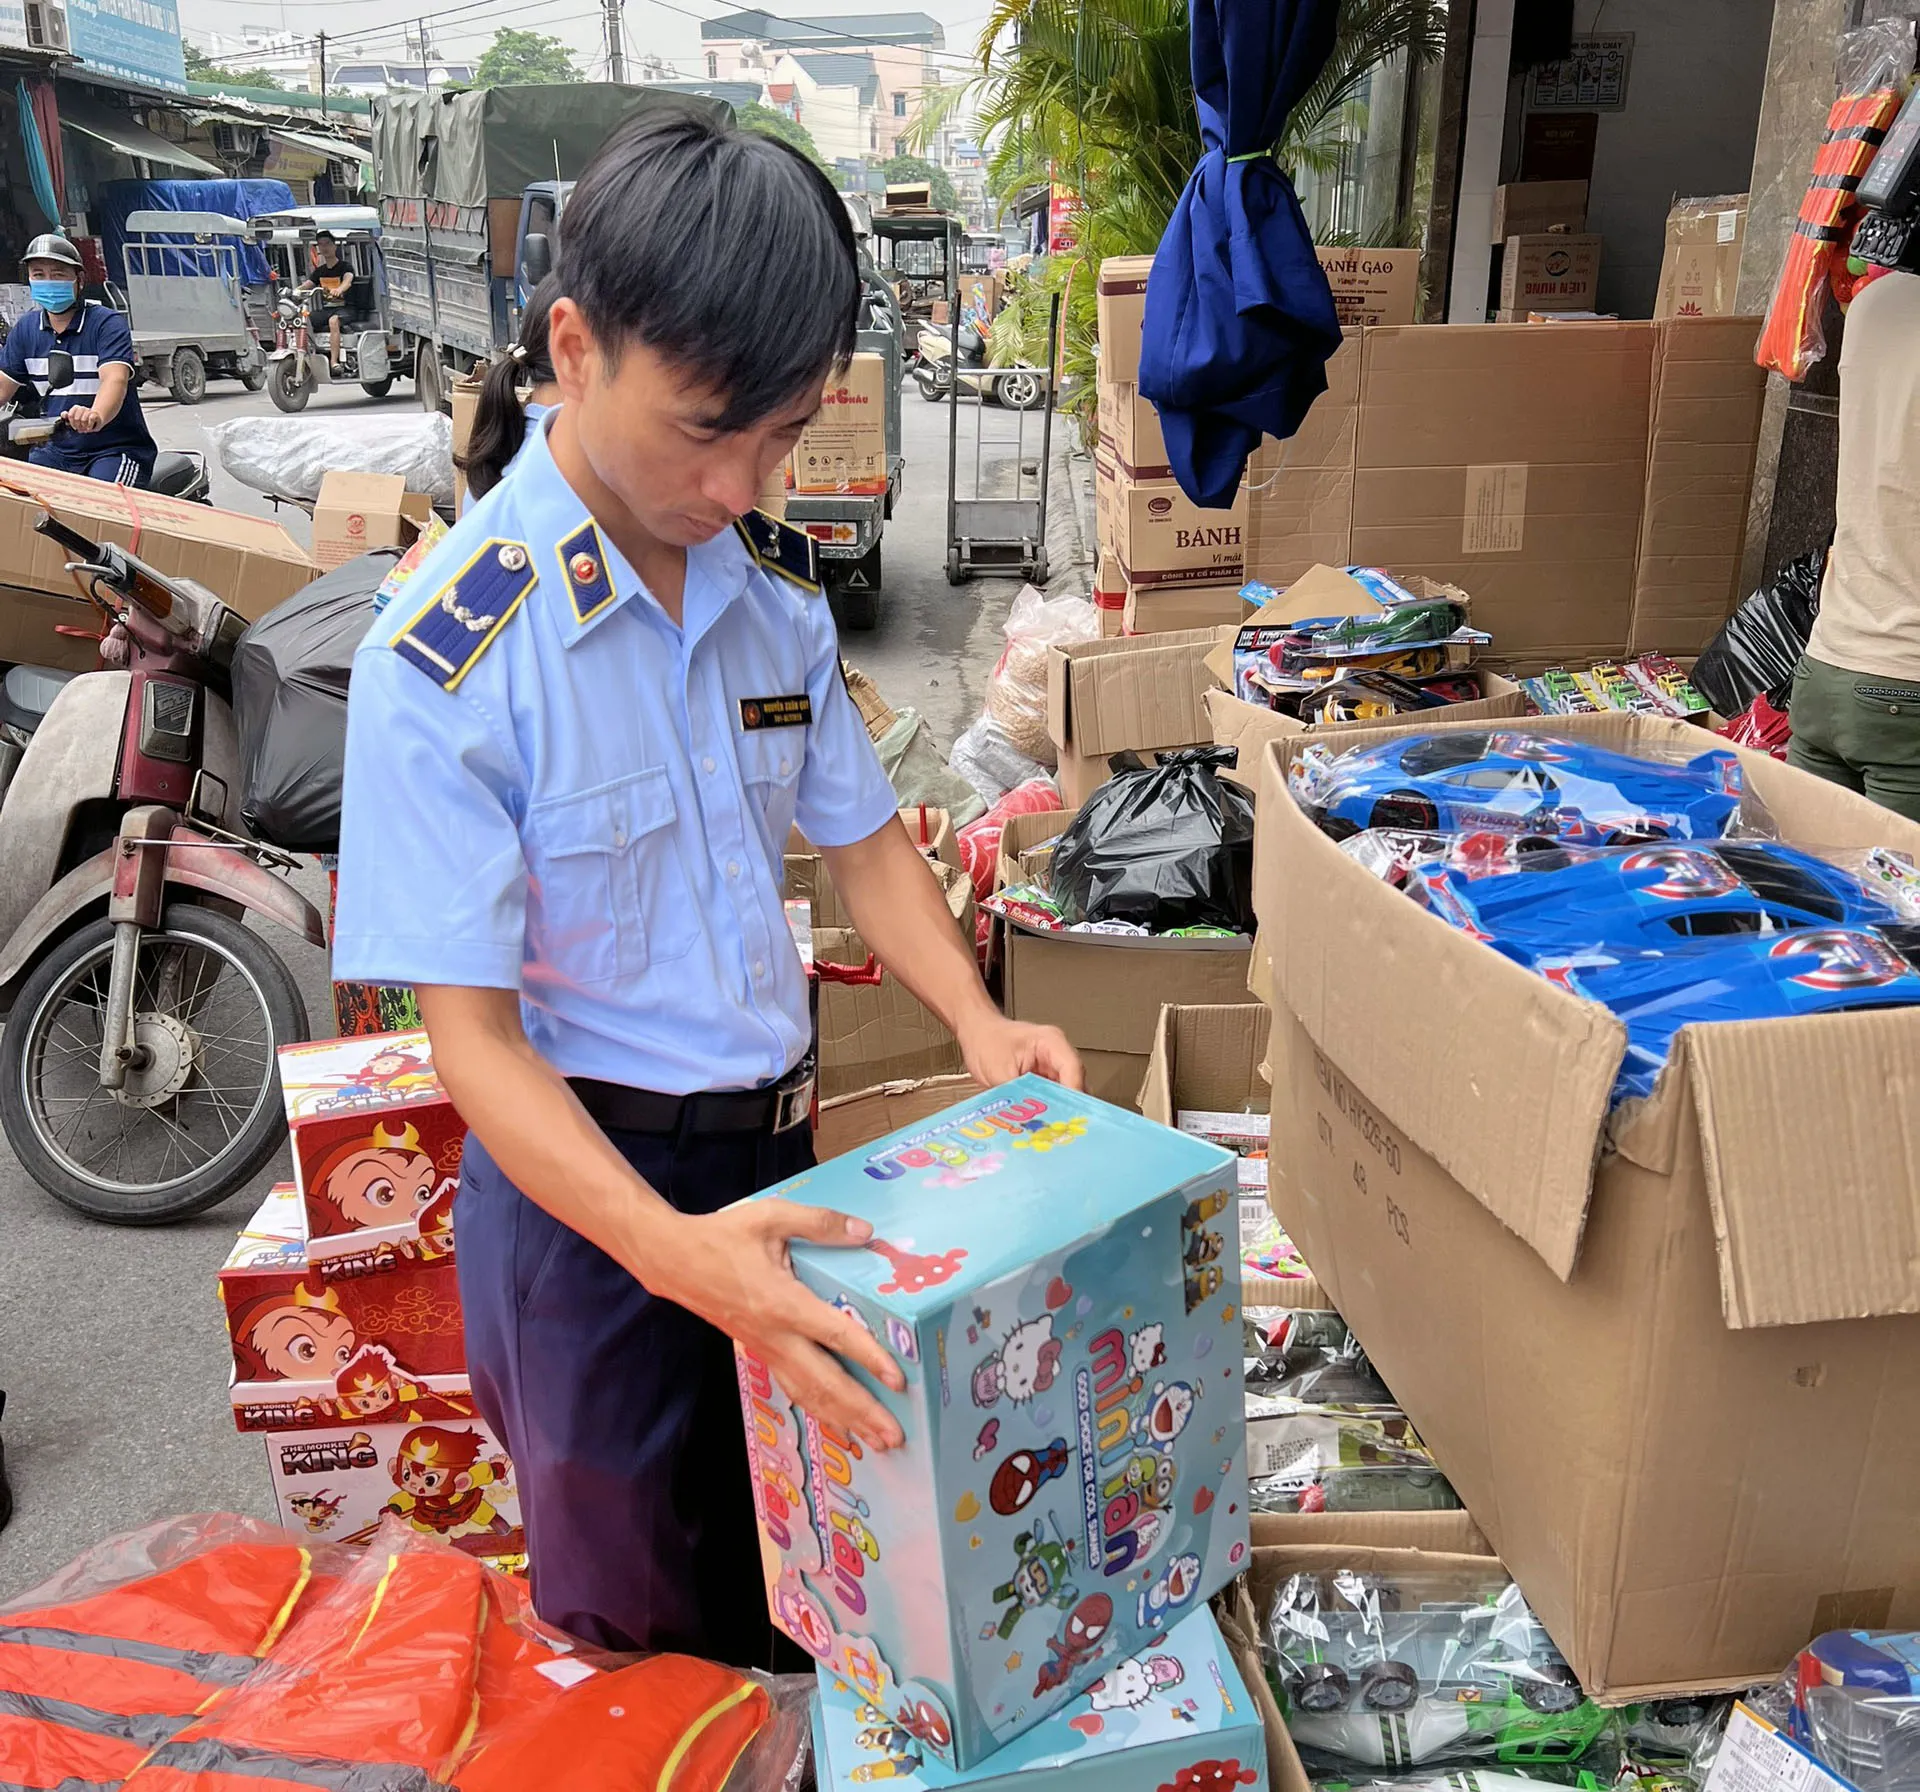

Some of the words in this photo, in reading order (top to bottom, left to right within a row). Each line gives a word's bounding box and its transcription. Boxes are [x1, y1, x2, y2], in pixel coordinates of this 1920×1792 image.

[1175, 526, 1241, 548] BÁNH
[320, 1253, 397, 1284] KING
[1076, 1371, 1089, 1410] GOOD
[244, 1408, 316, 1428] KING
[306, 1441, 350, 1451] MONKEY
[1079, 1411, 1092, 1458] CHOICE
[281, 1446, 378, 1476] KING
[1088, 1327, 1157, 1577] minifan
[1082, 1458, 1095, 1483] FOR
[1084, 1484, 1097, 1518] COOL
[819, 1421, 880, 1616] inifan
[1087, 1520, 1101, 1567] SUMMER
